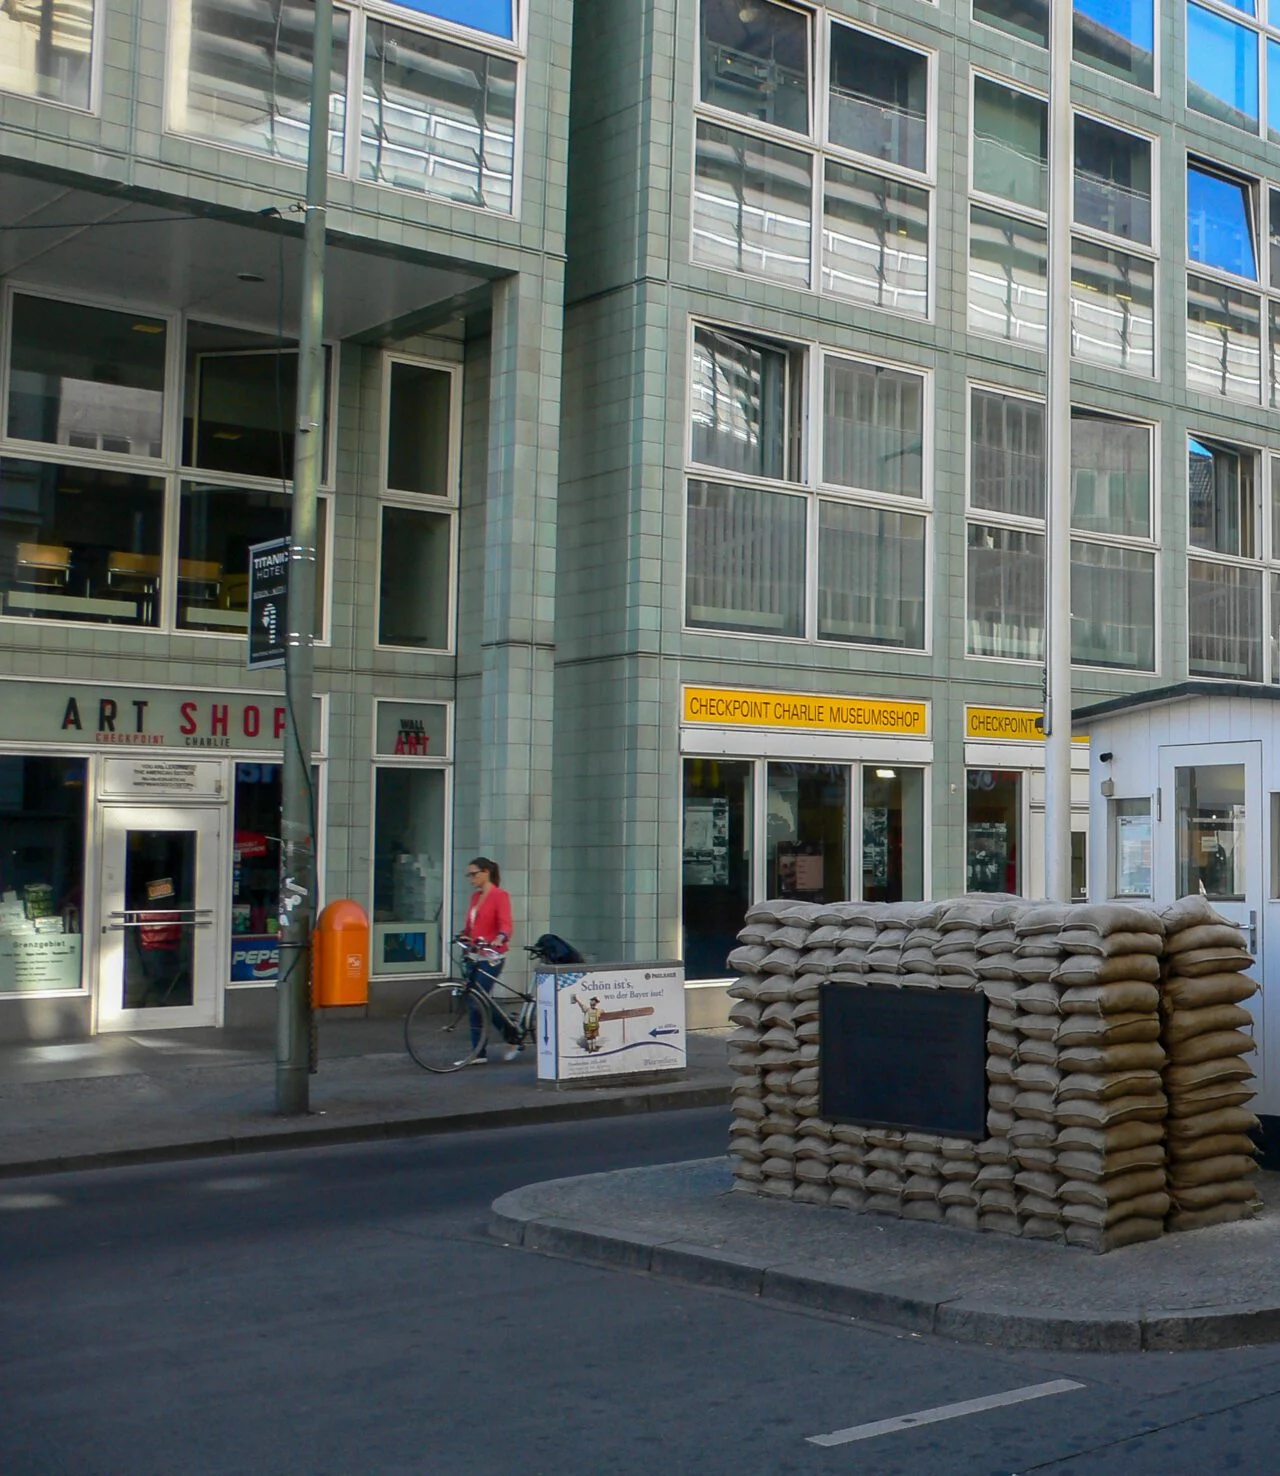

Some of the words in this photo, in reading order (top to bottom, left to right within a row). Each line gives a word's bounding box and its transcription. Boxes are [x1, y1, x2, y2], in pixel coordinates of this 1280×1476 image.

[256, 565, 286, 580] HOTEL
[61, 696, 148, 733] ART
[690, 696, 771, 718] CHECKPOINT
[774, 702, 825, 722] CHARLIE
[829, 705, 920, 728] MUSEUMSSHOP
[970, 714, 1033, 734] CHECKPOINT
[95, 733, 165, 745] CHECKPOINT
[185, 737, 231, 748] CHARLIE
[394, 735, 430, 755] ART
[581, 979, 611, 991] Schön
[616, 991, 628, 999] der
